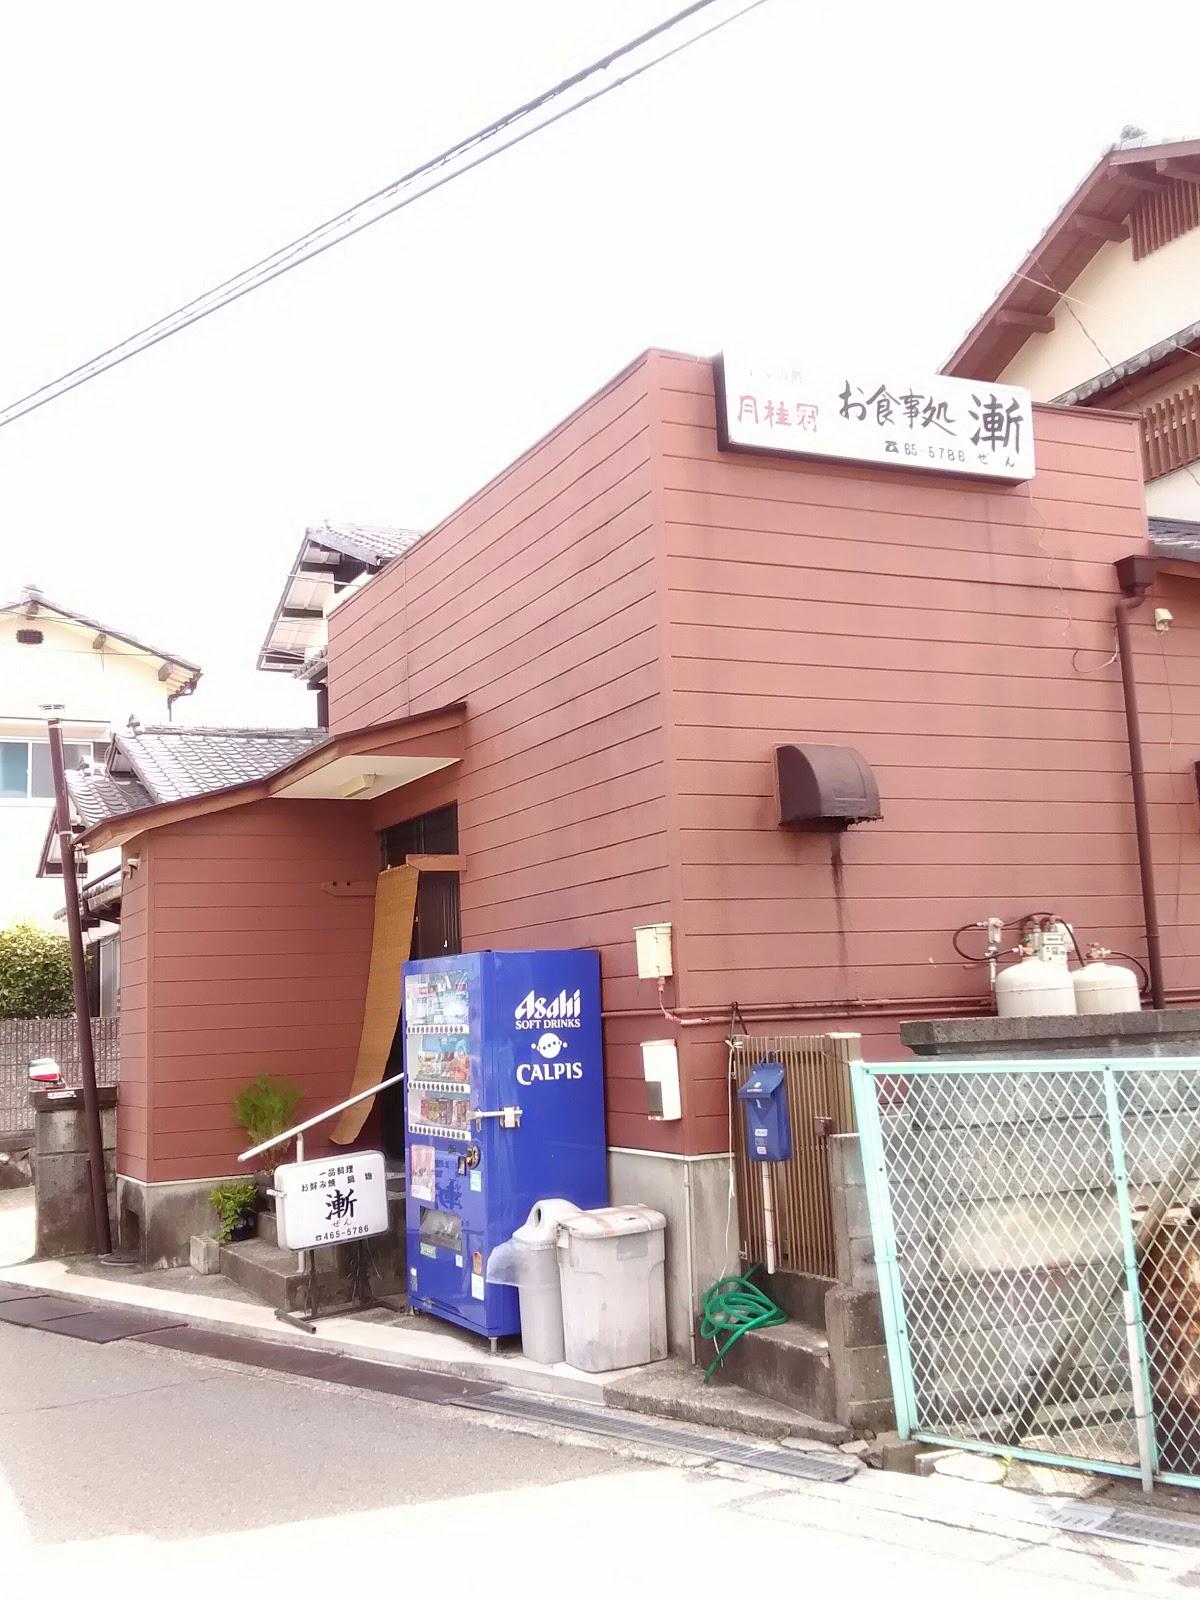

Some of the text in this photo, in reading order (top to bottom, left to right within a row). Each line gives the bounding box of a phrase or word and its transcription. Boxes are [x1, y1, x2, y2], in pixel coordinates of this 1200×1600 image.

[737, 394, 819, 432] 月桂冠
[838, 379, 1024, 455] お食事処 漸
[514, 989, 581, 1020] Asahi
[515, 1018, 581, 1030] SOFT DRINKS
[516, 1062, 583, 1086] CALPIS
[324, 1188, 358, 1221] 漸
